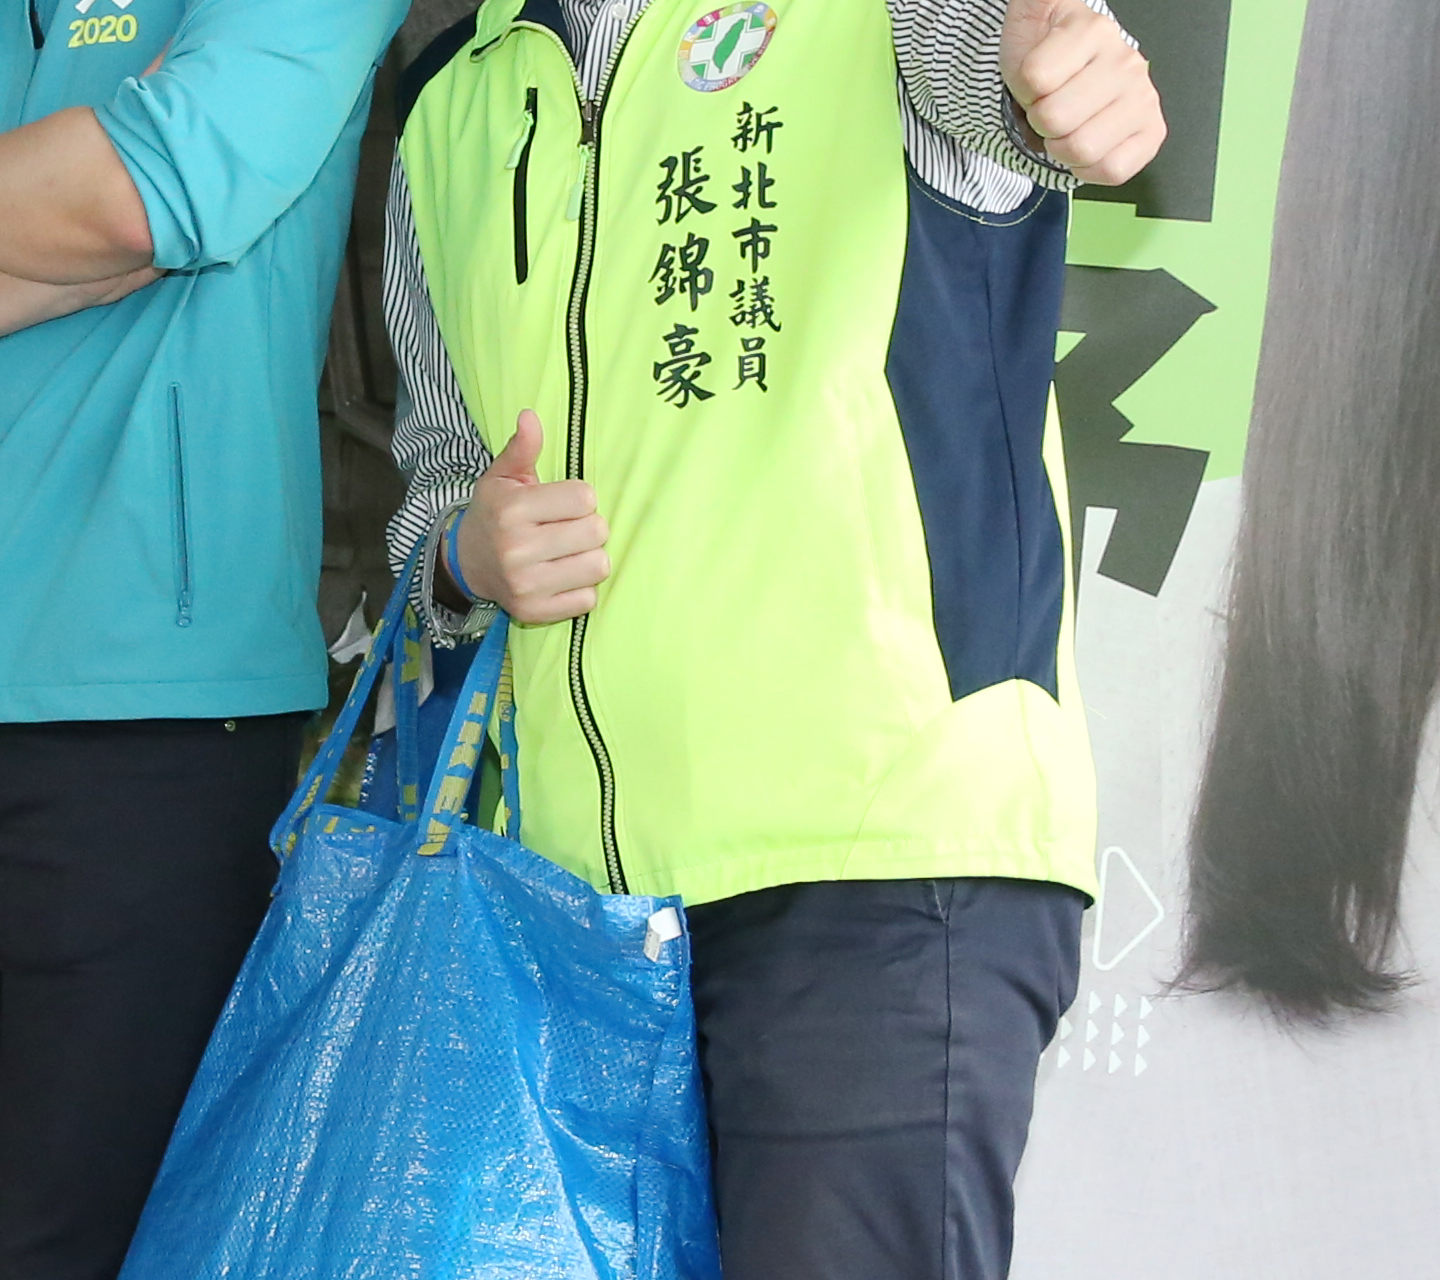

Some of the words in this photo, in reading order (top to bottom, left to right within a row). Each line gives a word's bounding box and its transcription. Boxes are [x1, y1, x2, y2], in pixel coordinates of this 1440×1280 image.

[68, 14, 138, 48] 2020
[648, 146, 717, 409] 張錦豪
[729, 101, 784, 392] 新北市議員
